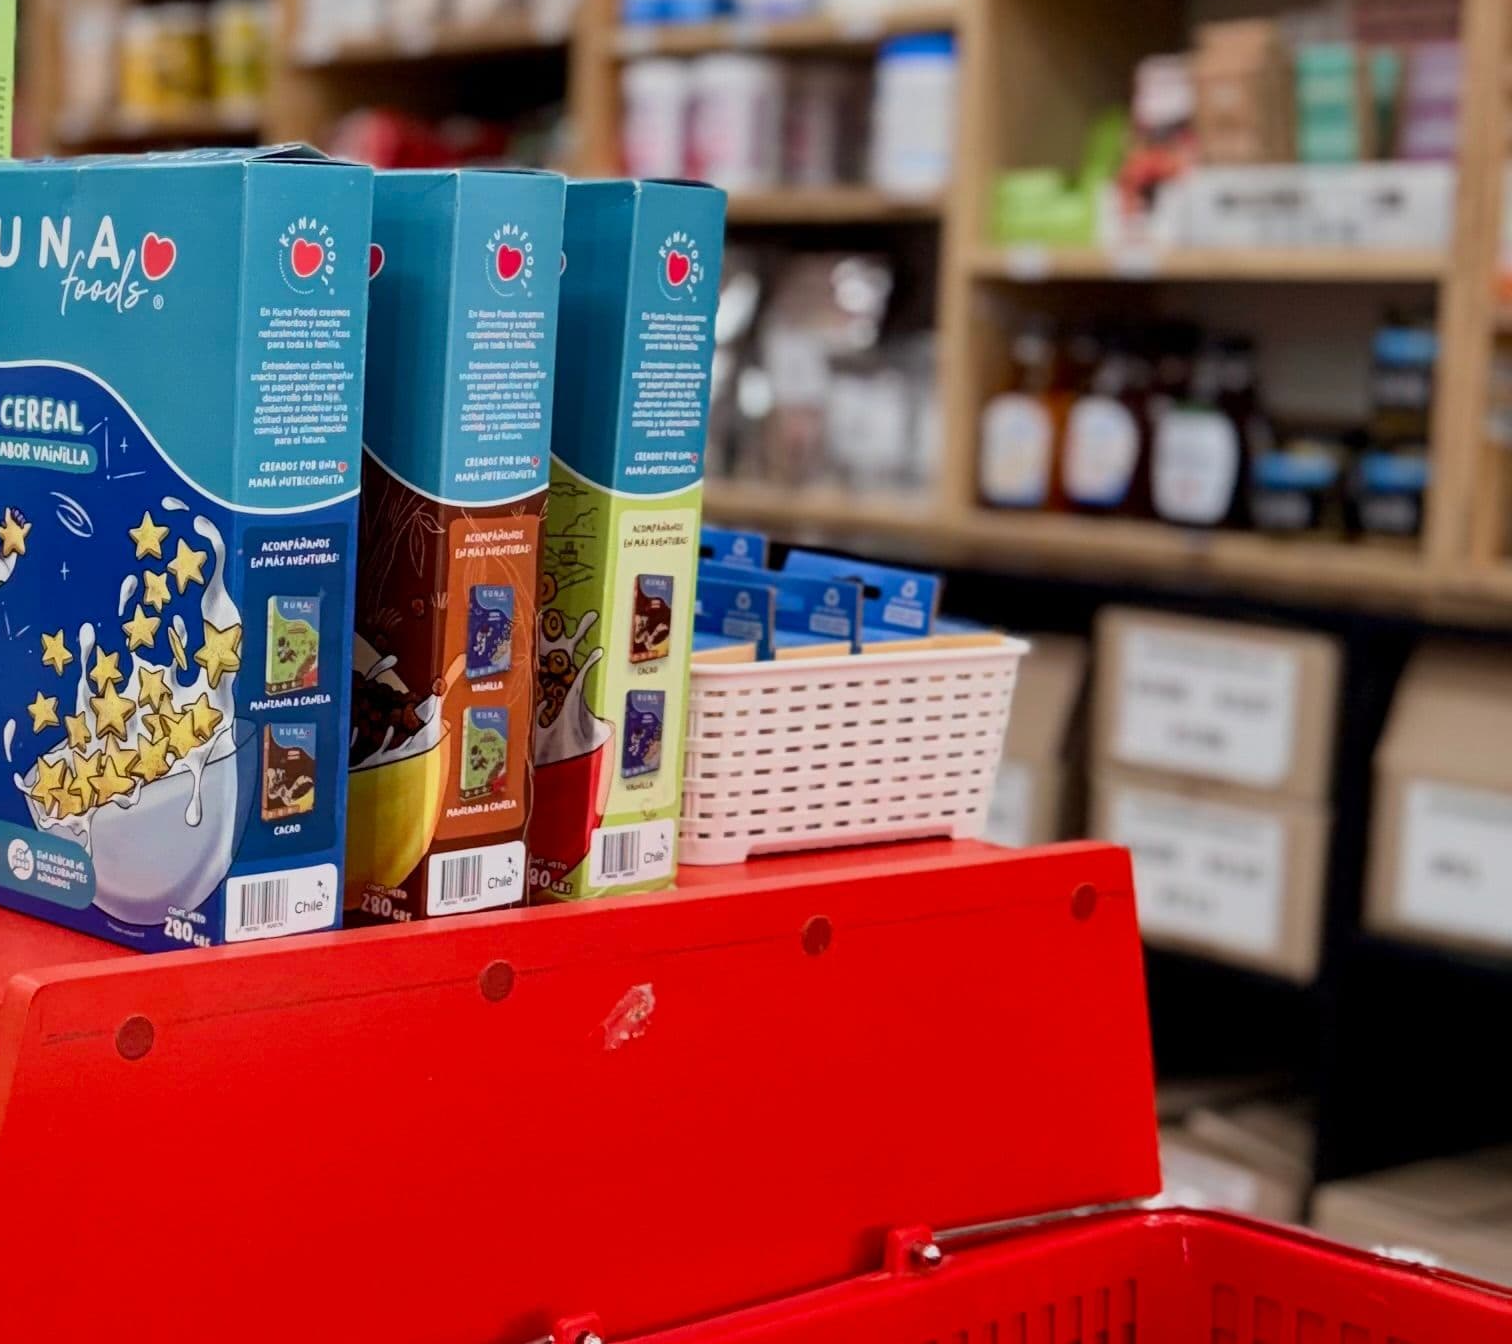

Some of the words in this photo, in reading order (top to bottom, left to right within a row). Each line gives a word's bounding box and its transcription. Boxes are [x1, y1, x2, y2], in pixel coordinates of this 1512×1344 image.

[60, 249, 148, 315] foods
[0, 398, 84, 433] CEREAL
[33, 444, 89, 466] VAINILLA
[260, 461, 297, 473] CREADOS
[300, 460, 316, 470] POR
[249, 477, 276, 488] MAMÁ
[455, 548, 466, 558] EN
[250, 557, 263, 568] EN
[265, 555, 284, 567] MÁS
[250, 697, 292, 711] MANZANA
[301, 694, 331, 705] CANELA
[274, 824, 301, 835] CACAO
[488, 876, 512, 890] Chile
[528, 868, 551, 886] 80
[295, 898, 323, 914] Chile
[361, 893, 392, 917] 280
[164, 916, 192, 942] 280
